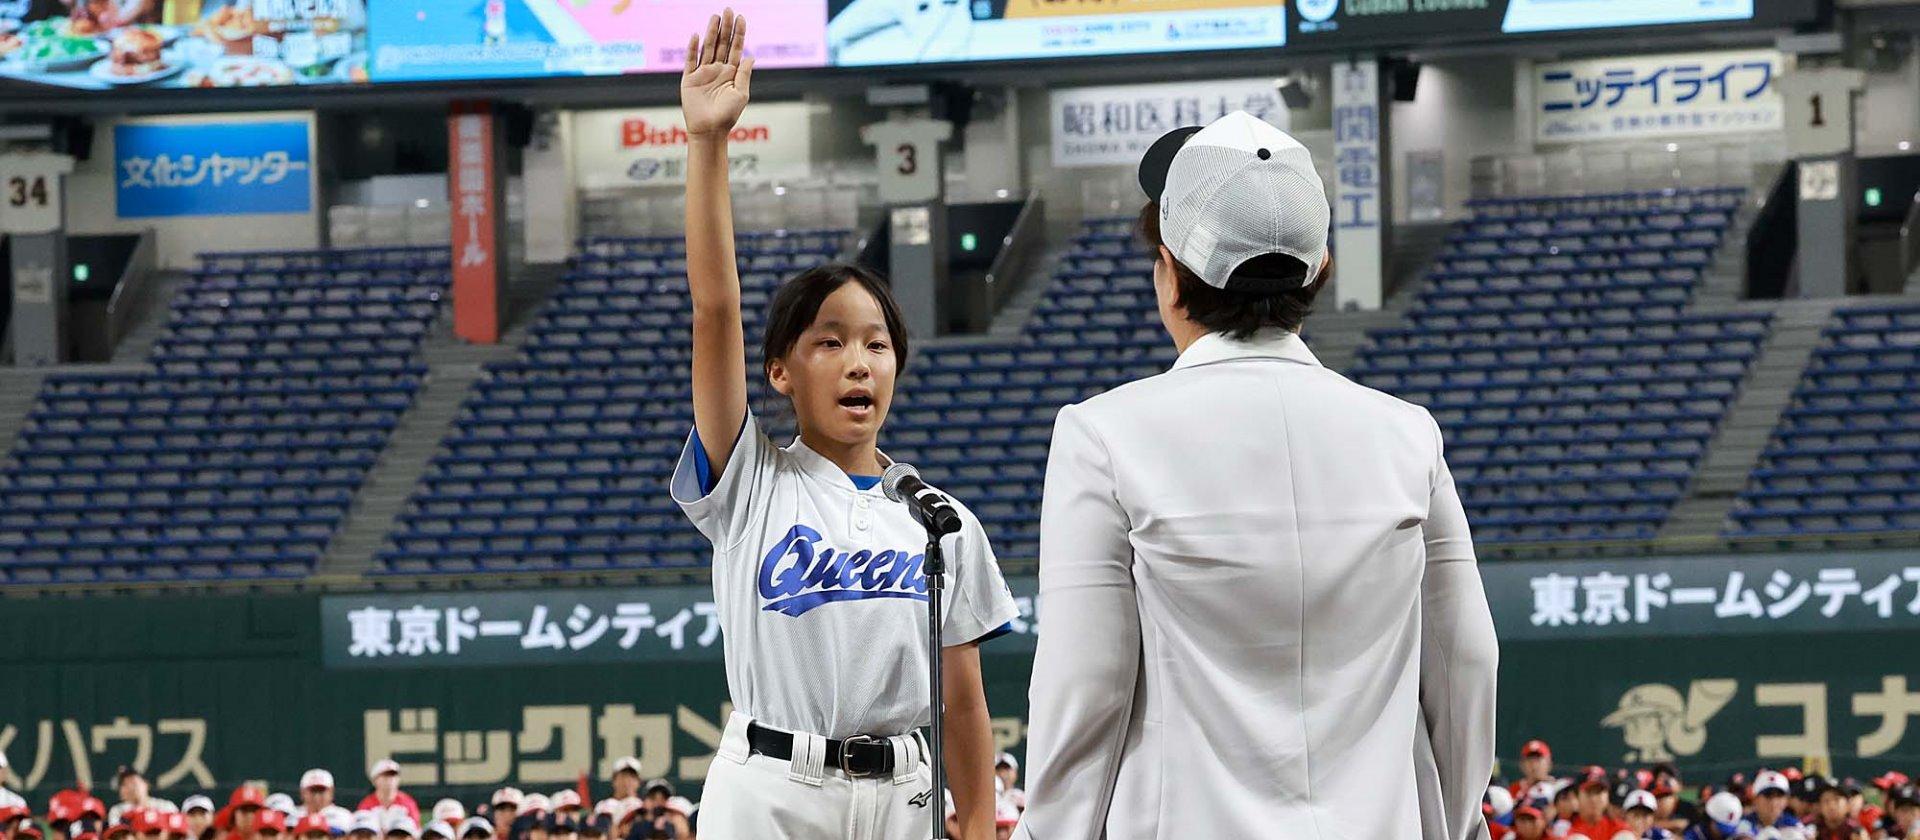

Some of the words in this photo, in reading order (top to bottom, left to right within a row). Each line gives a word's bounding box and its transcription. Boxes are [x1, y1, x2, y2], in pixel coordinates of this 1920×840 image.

[1543, 61, 1772, 111] ニッテイライフ
[1810, 93, 1824, 126] 1
[121, 151, 309, 188] 文化シャッター
[897, 144, 916, 175] 3
[1334, 105, 1377, 228] 関電工
[8, 176, 48, 207] 34
